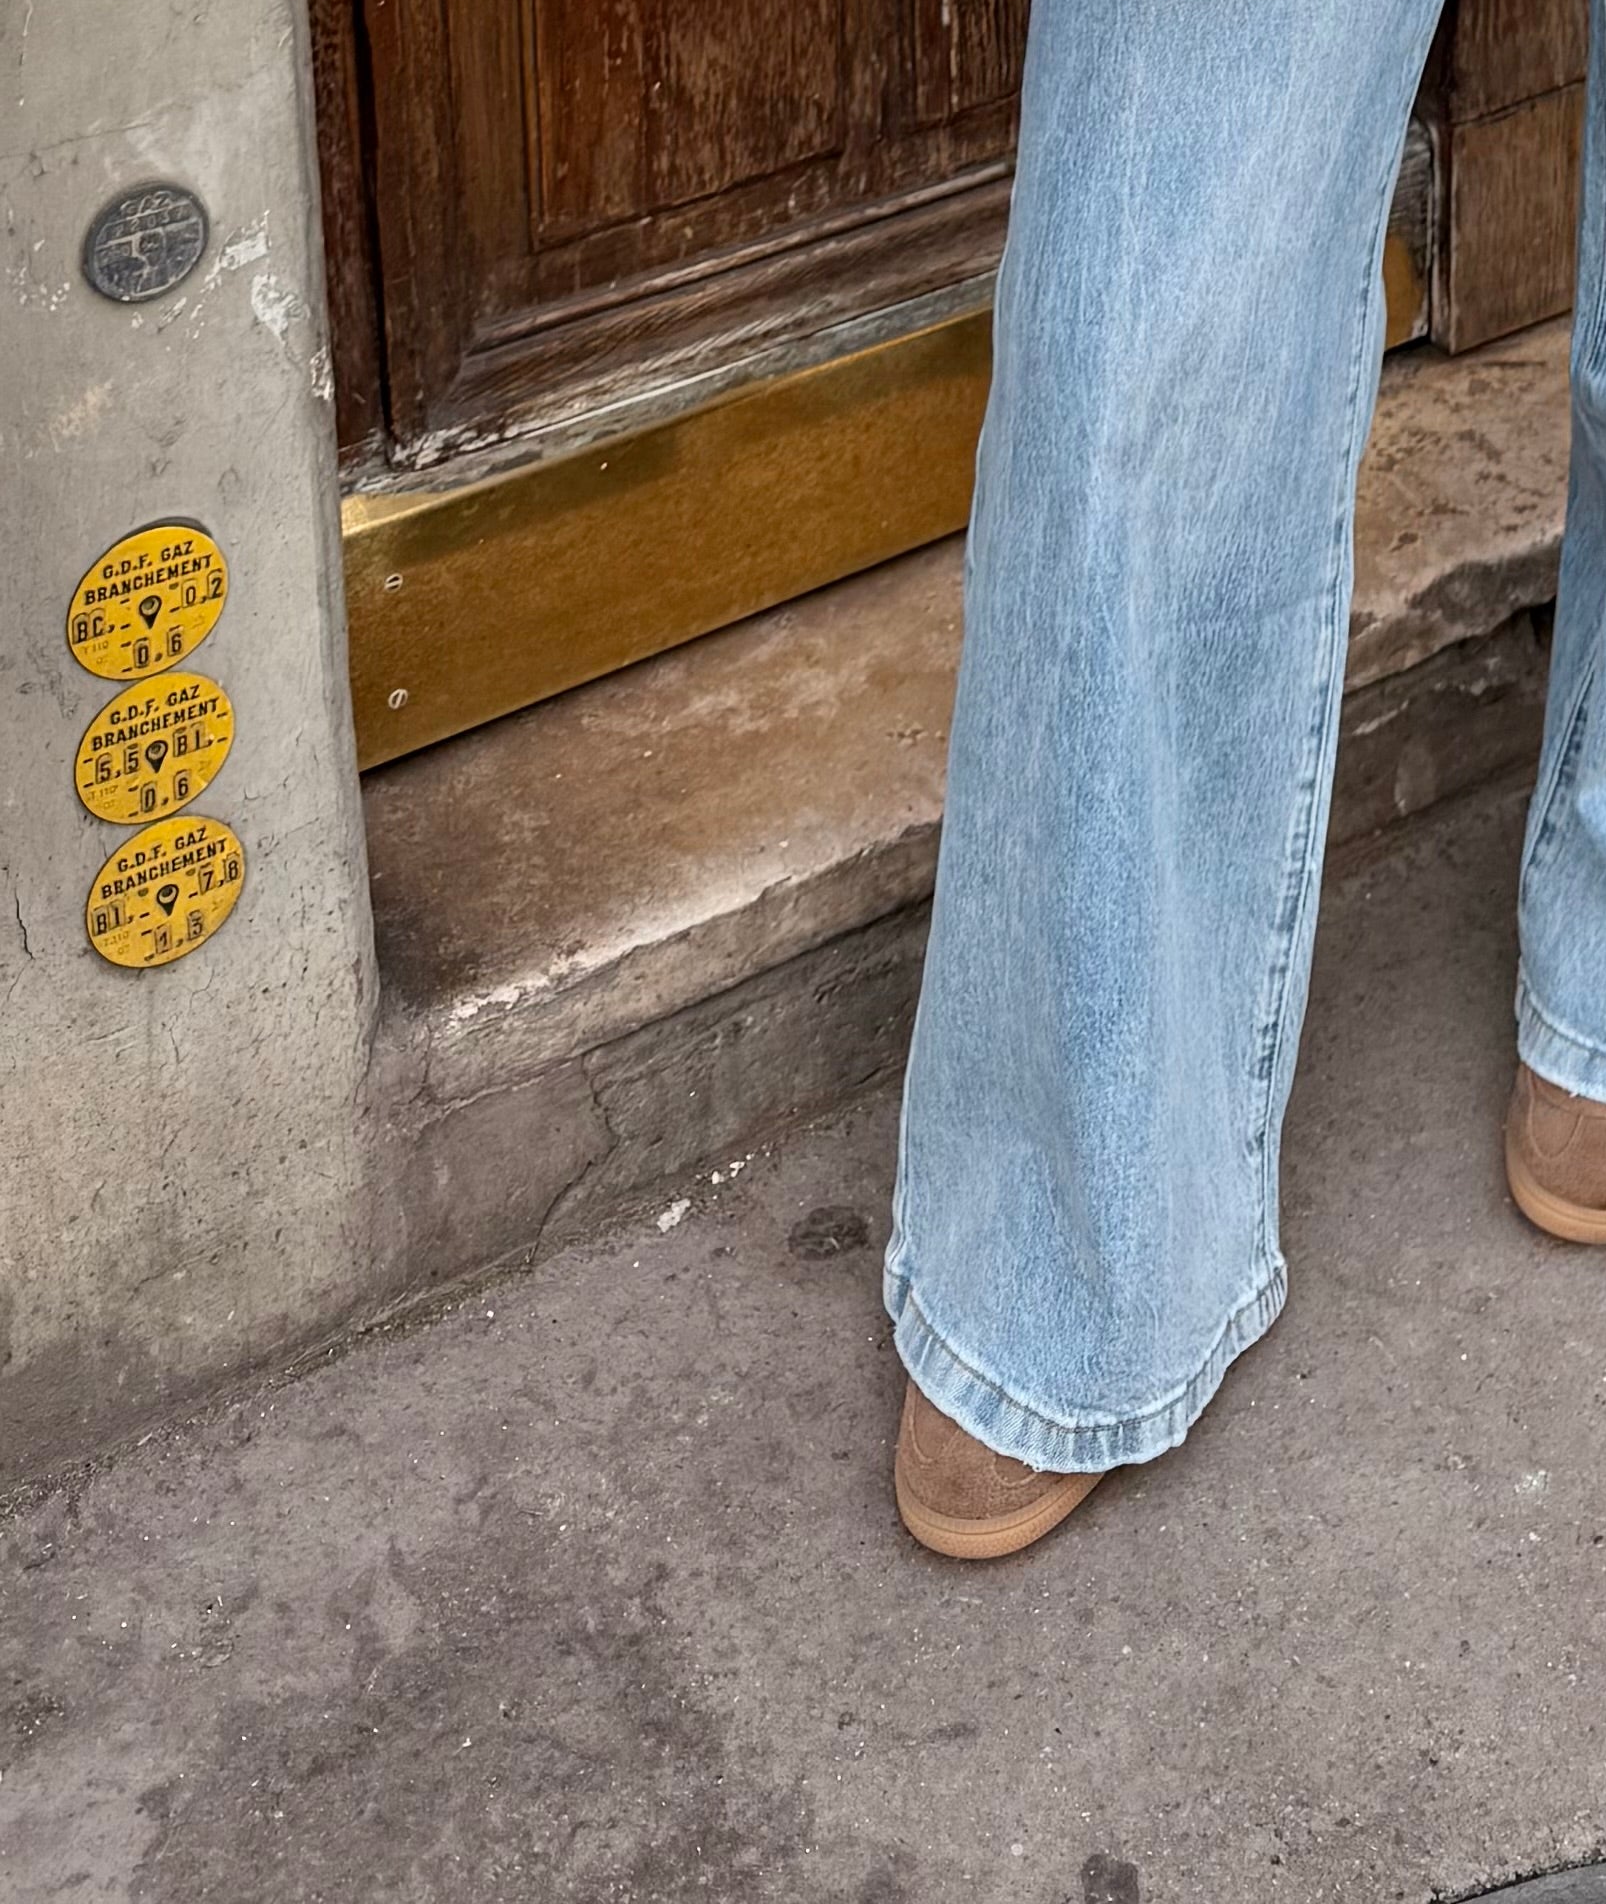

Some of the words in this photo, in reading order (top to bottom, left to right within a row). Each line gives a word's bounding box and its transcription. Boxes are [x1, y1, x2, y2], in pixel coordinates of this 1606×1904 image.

[84, 553, 214, 606] BRANCHEMENT
[102, 553, 153, 580] G.D.F.
[161, 540, 194, 562] GAZ
[92, 697, 221, 751] BRANCHEMENT
[109, 699, 160, 727] G.D.F.
[166, 684, 201, 707] GAZ
[102, 838, 227, 899] BRANCHEMENT
[117, 844, 167, 873] G.D.F.
[175, 826, 208, 850] GAZ
